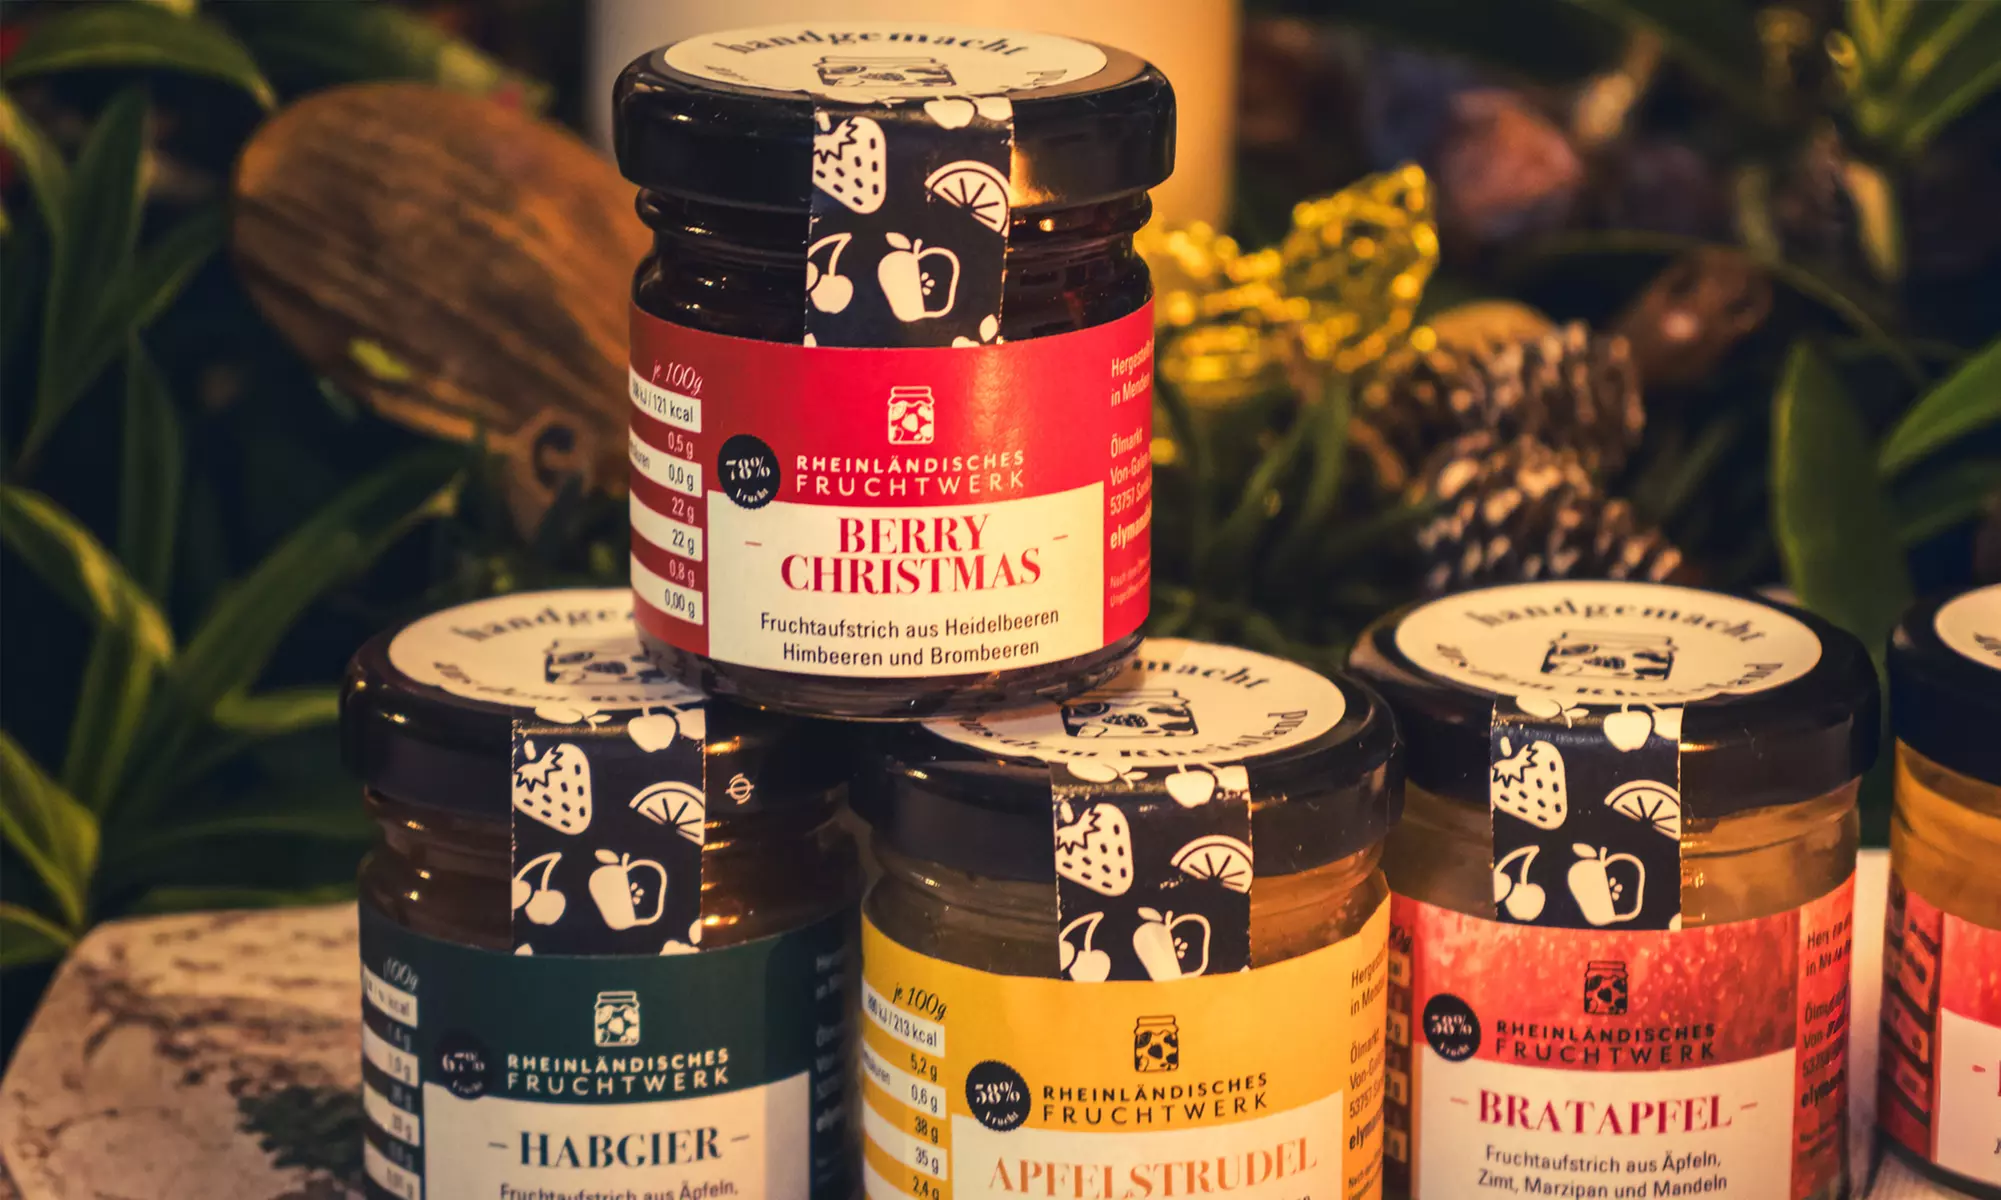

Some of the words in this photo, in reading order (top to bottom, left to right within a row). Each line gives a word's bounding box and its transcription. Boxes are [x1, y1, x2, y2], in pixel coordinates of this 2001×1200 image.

[713, 30, 1029, 56] handgemacht
[665, 361, 704, 396] 100g
[670, 400, 694, 423] kcal
[1111, 388, 1121, 408] in
[668, 430, 684, 453] 0,5
[686, 441, 694, 460] g
[725, 456, 771, 481] 78%
[796, 449, 1024, 474] RHEINLÄNDISCHES
[668, 463, 684, 485] 0,0
[686, 473, 694, 492] g
[796, 469, 1024, 497] FRUCHTWERK
[672, 496, 684, 518] 22
[687, 506, 695, 524] g
[1110, 487, 1135, 516] 53757
[672, 528, 684, 548] 22
[687, 537, 695, 556] g
[837, 513, 992, 554] BERRY
[669, 558, 685, 581] 0,8
[687, 569, 695, 588] g
[780, 547, 1042, 595] CHRISTMAS
[664, 588, 685, 612] 0,00
[688, 601, 695, 619] g
[760, 612, 900, 639] Fruchtaufstrich
[906, 621, 939, 639] aus
[946, 608, 1059, 637] Heidelbeeren
[1464, 597, 1766, 643] handgemacht
[783, 642, 883, 667] Himbeeren
[889, 646, 923, 667] und
[930, 639, 1040, 666] Brombeeren
[907, 986, 947, 1022] 100g
[1350, 998, 1360, 1017] in
[894, 1013, 910, 1037] 213
[913, 1022, 937, 1047] kcal
[1496, 1019, 1716, 1043] RHEINLÄNDISCHES
[507, 1048, 729, 1074] RHEINLÄNDISCHES
[910, 1052, 927, 1076] 5,2
[930, 1064, 938, 1082] g
[1496, 1040, 1715, 1065] FRUCHTWERK
[507, 1066, 729, 1096] FRUCHTWERK
[974, 1080, 1021, 1105] 58%
[1043, 1072, 1268, 1102] RHEINLÄNDISCHES
[911, 1083, 928, 1105] 0,6
[930, 1097, 938, 1114] g
[1043, 1092, 1268, 1125] FRUCHTWERK
[1477, 1088, 1733, 1136] BRATAPFEL
[914, 1115, 928, 1136] 38
[931, 1128, 939, 1144] g
[520, 1126, 722, 1168] HABGIER
[915, 1146, 929, 1167] 35
[931, 1159, 939, 1175] g
[1486, 1144, 1621, 1173] Fruchtaufstrich
[1626, 1156, 1657, 1173] aus
[1662, 1149, 1722, 1175] Äpfeln,
[988, 1136, 1318, 1200] APFELSTRUDEL
[912, 1175, 929, 1199] 2,4
[1478, 1168, 1519, 1195] Zimt,
[1524, 1176, 1608, 1200] Marzipan
[1614, 1178, 1648, 1198] und
[1654, 1174, 1728, 1197] Mandeln
